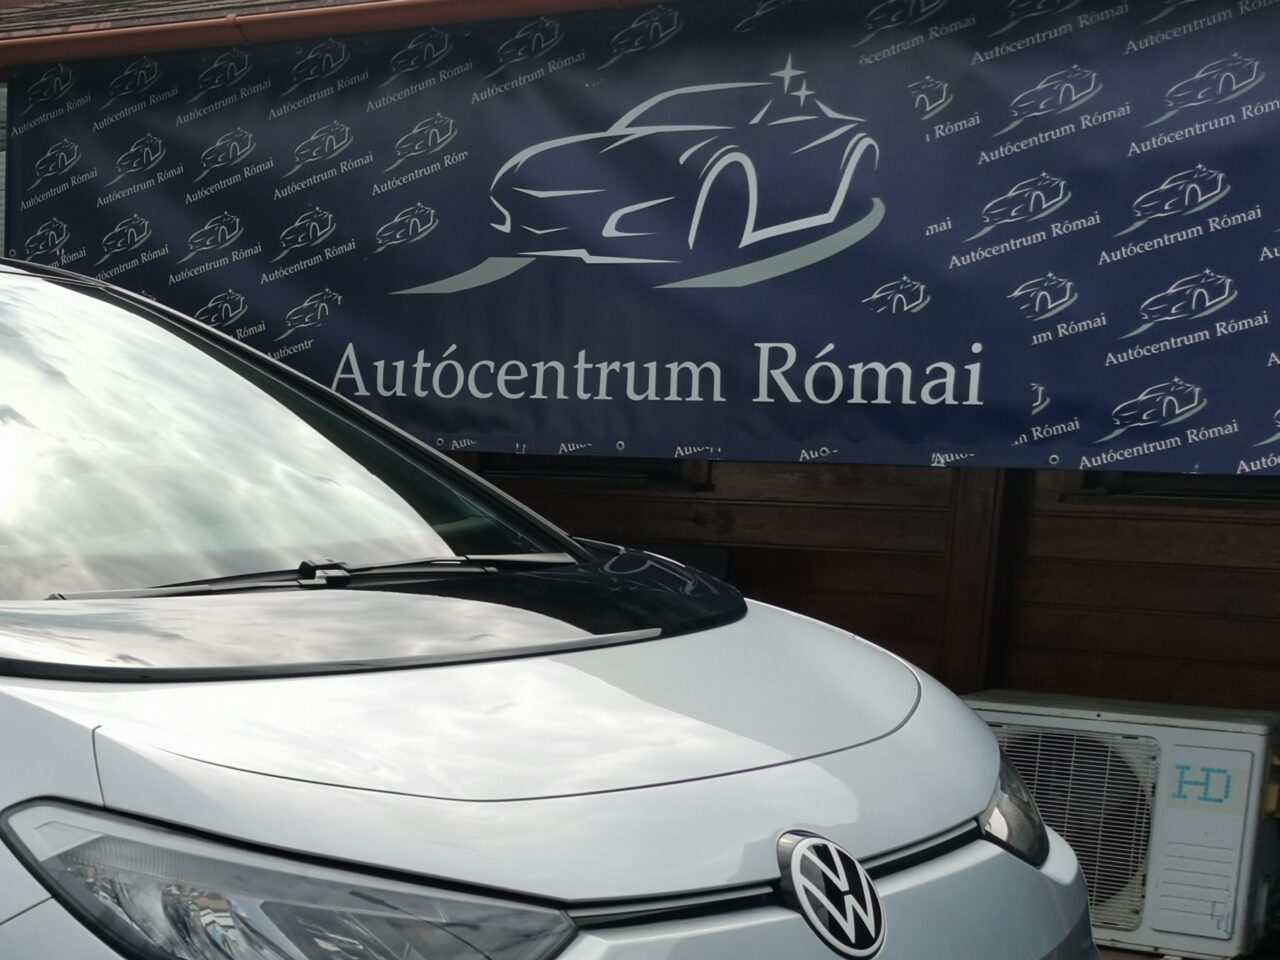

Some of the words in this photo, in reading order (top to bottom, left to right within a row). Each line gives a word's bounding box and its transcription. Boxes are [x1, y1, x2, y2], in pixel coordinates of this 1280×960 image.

[858, 34, 924, 65] ócentrum
[928, 13, 976, 41] Római
[971, 23, 1073, 66] Autócentrum
[1077, 3, 1129, 28] Római
[1123, 8, 1233, 55] Autócentrum
[268, 87, 334, 120] Autócentrum
[337, 68, 369, 90] Római
[366, 78, 436, 112] Autócentrum
[439, 58, 473, 81] Római
[471, 68, 545, 104] Autócentrum
[547, 49, 585, 73] Római
[92, 101, 146, 133] Autócentrum
[149, 87, 178, 105] Római
[175, 95, 237, 126] Autócentrum
[240, 80, 272, 99] Római
[934, 112, 981, 139] Római
[977, 121, 1076, 165] Autócentrum
[1080, 102, 1131, 130] Római
[1127, 113, 1236, 157] Autócentrum
[1241, 98, 1280, 120] Róm
[20, 182, 69, 211] Autócentrum
[70, 167, 98, 187] Római
[96, 175, 155, 208] Autócentrum
[157, 162, 184, 183] Római
[185, 173, 242, 205] Autócentrum
[244, 157, 274, 178] Római
[273, 167, 337, 200] Autócentrum
[340, 151, 374, 173] Római
[371, 162, 441, 196] Autócentrum
[443, 151, 468, 168] Róm
[925, 217, 953, 236] mai
[948, 230, 1047, 269] Autócentrum
[1051, 211, 1101, 237] Római
[1097, 226, 1203, 265] Autócentrum
[1208, 204, 1262, 232] Római
[60, 247, 87, 267] Római
[96, 258, 139, 281] tócentrum
[140, 244, 169, 263] Római
[168, 257, 229, 285] Autócentrum
[231, 242, 262, 262] Római
[260, 255, 323, 285] Autócentrum
[324, 238, 356, 259] Római
[236, 320, 266, 340] Római
[1056, 312, 1107, 338] Római
[1104, 329, 1210, 367] Autócentrum
[1215, 310, 1269, 337] Római
[330, 341, 726, 402] Autócentrum
[752, 341, 984, 406] Római
[1031, 417, 1080, 441] Római
[1079, 435, 1182, 470] Autócentrum
[1186, 419, 1239, 444] Római
